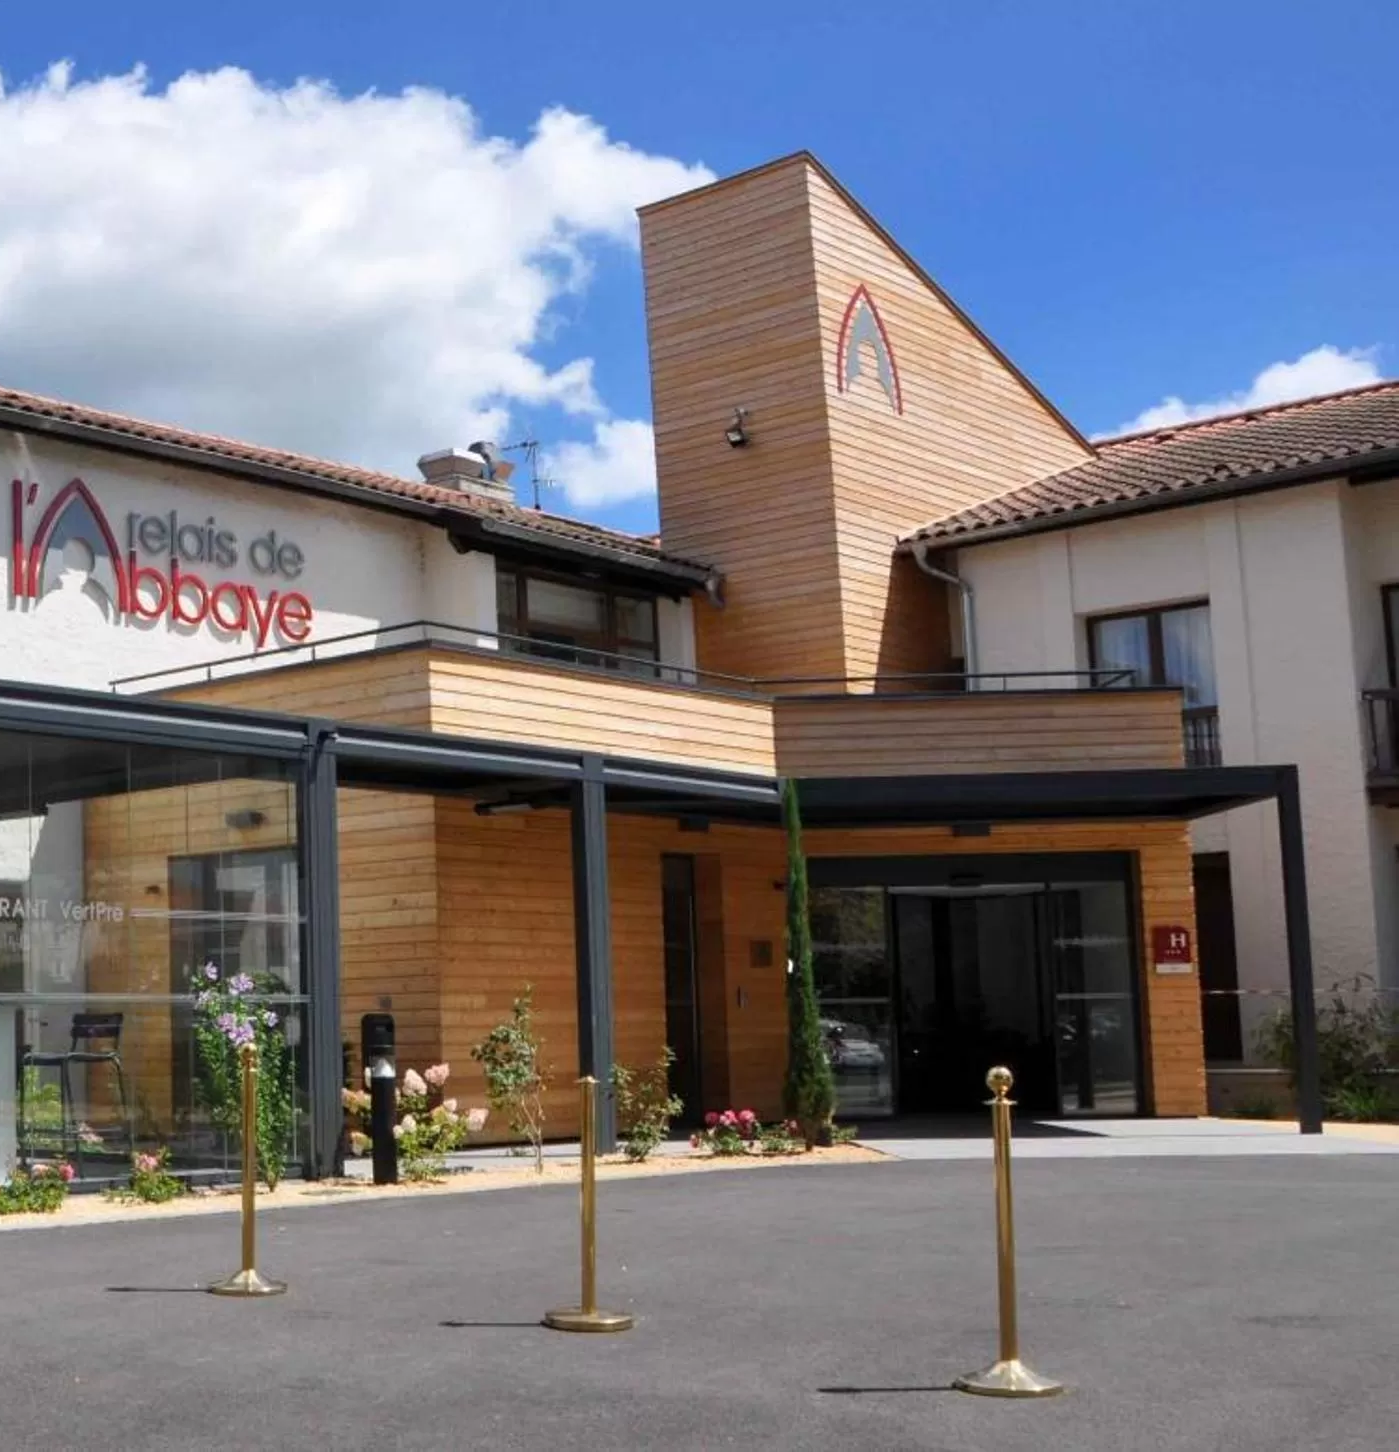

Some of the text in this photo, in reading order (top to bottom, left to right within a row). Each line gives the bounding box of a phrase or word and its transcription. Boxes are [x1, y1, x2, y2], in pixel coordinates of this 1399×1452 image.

[126, 508, 305, 579] relais de
[1170, 932, 1187, 949] H
